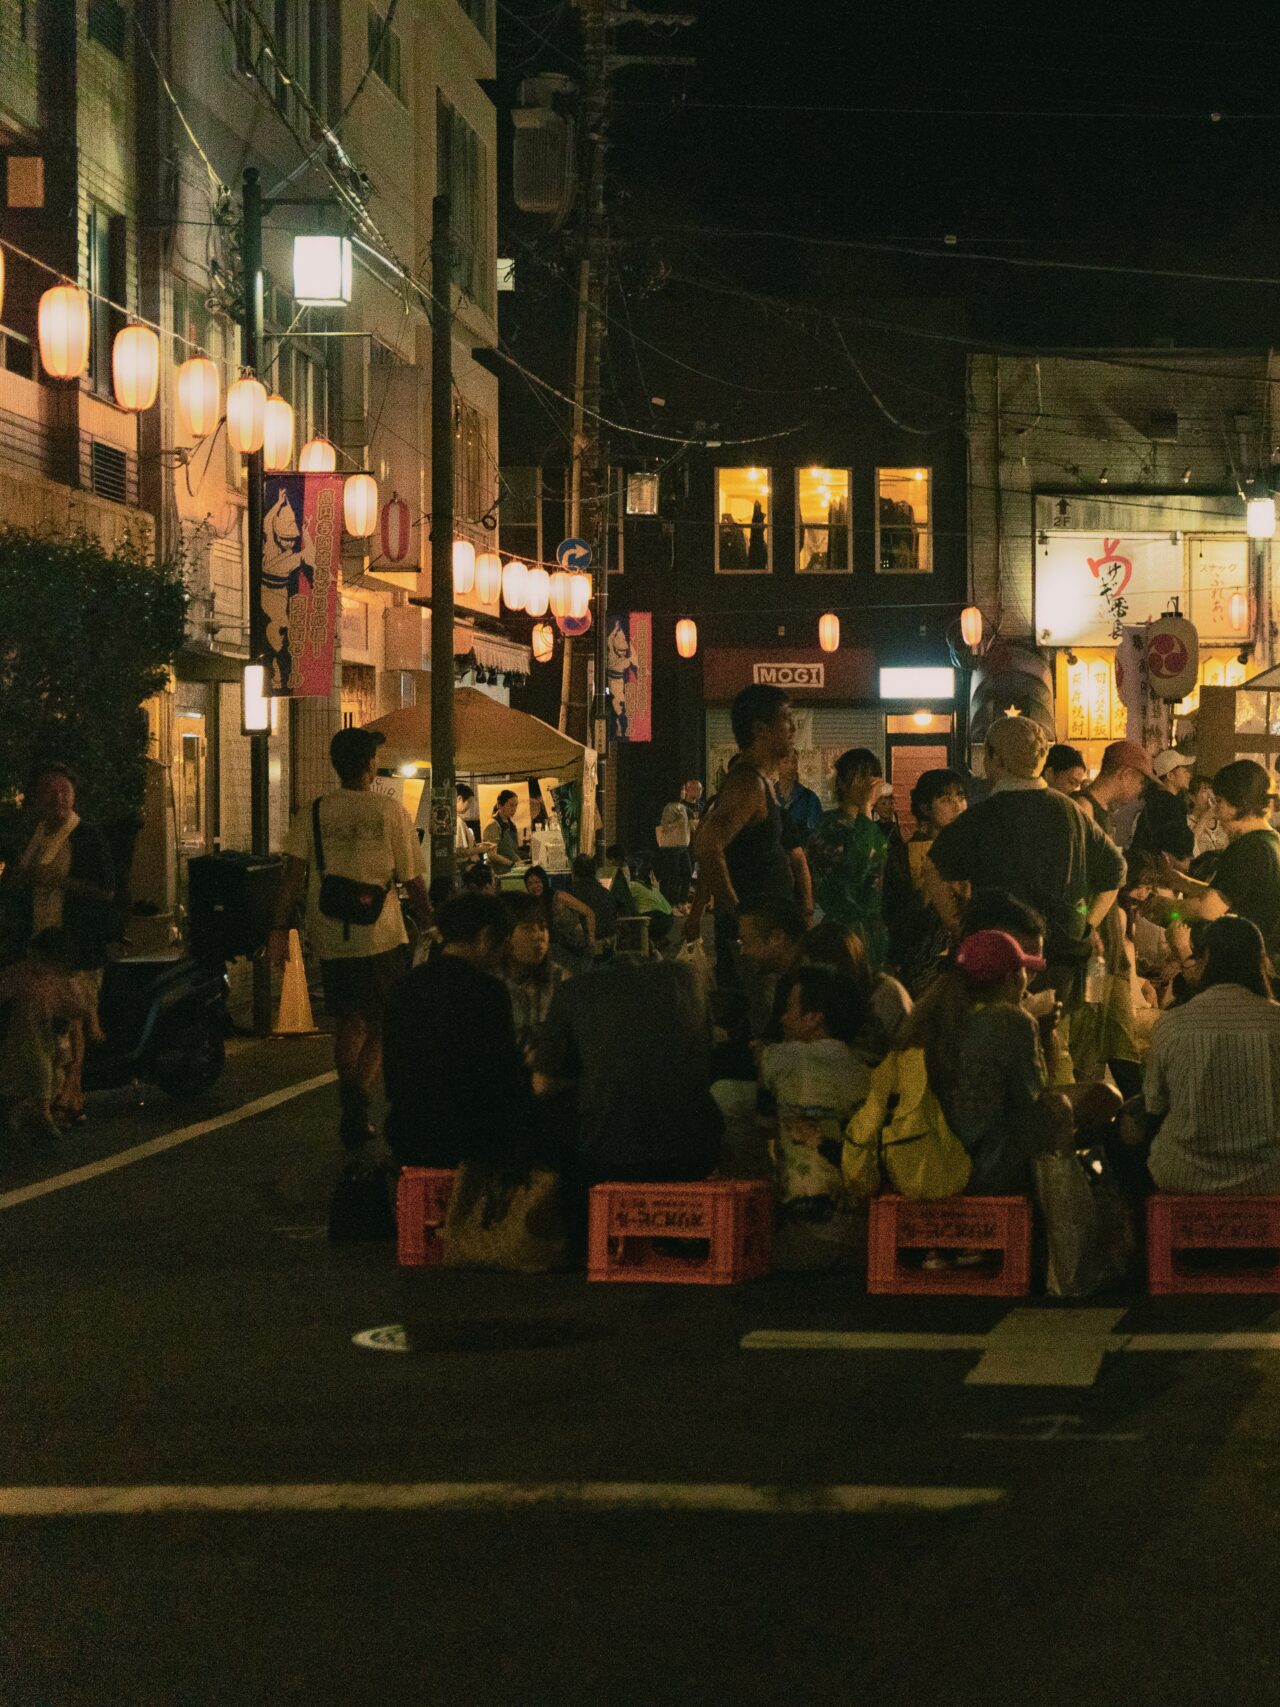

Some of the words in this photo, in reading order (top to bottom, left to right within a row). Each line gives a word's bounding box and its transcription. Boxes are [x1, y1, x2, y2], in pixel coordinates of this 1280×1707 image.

[1199, 563, 1237, 573] スナック
[1210, 573, 1224, 623] ふれあい
[759, 667, 819, 684] MOGI
